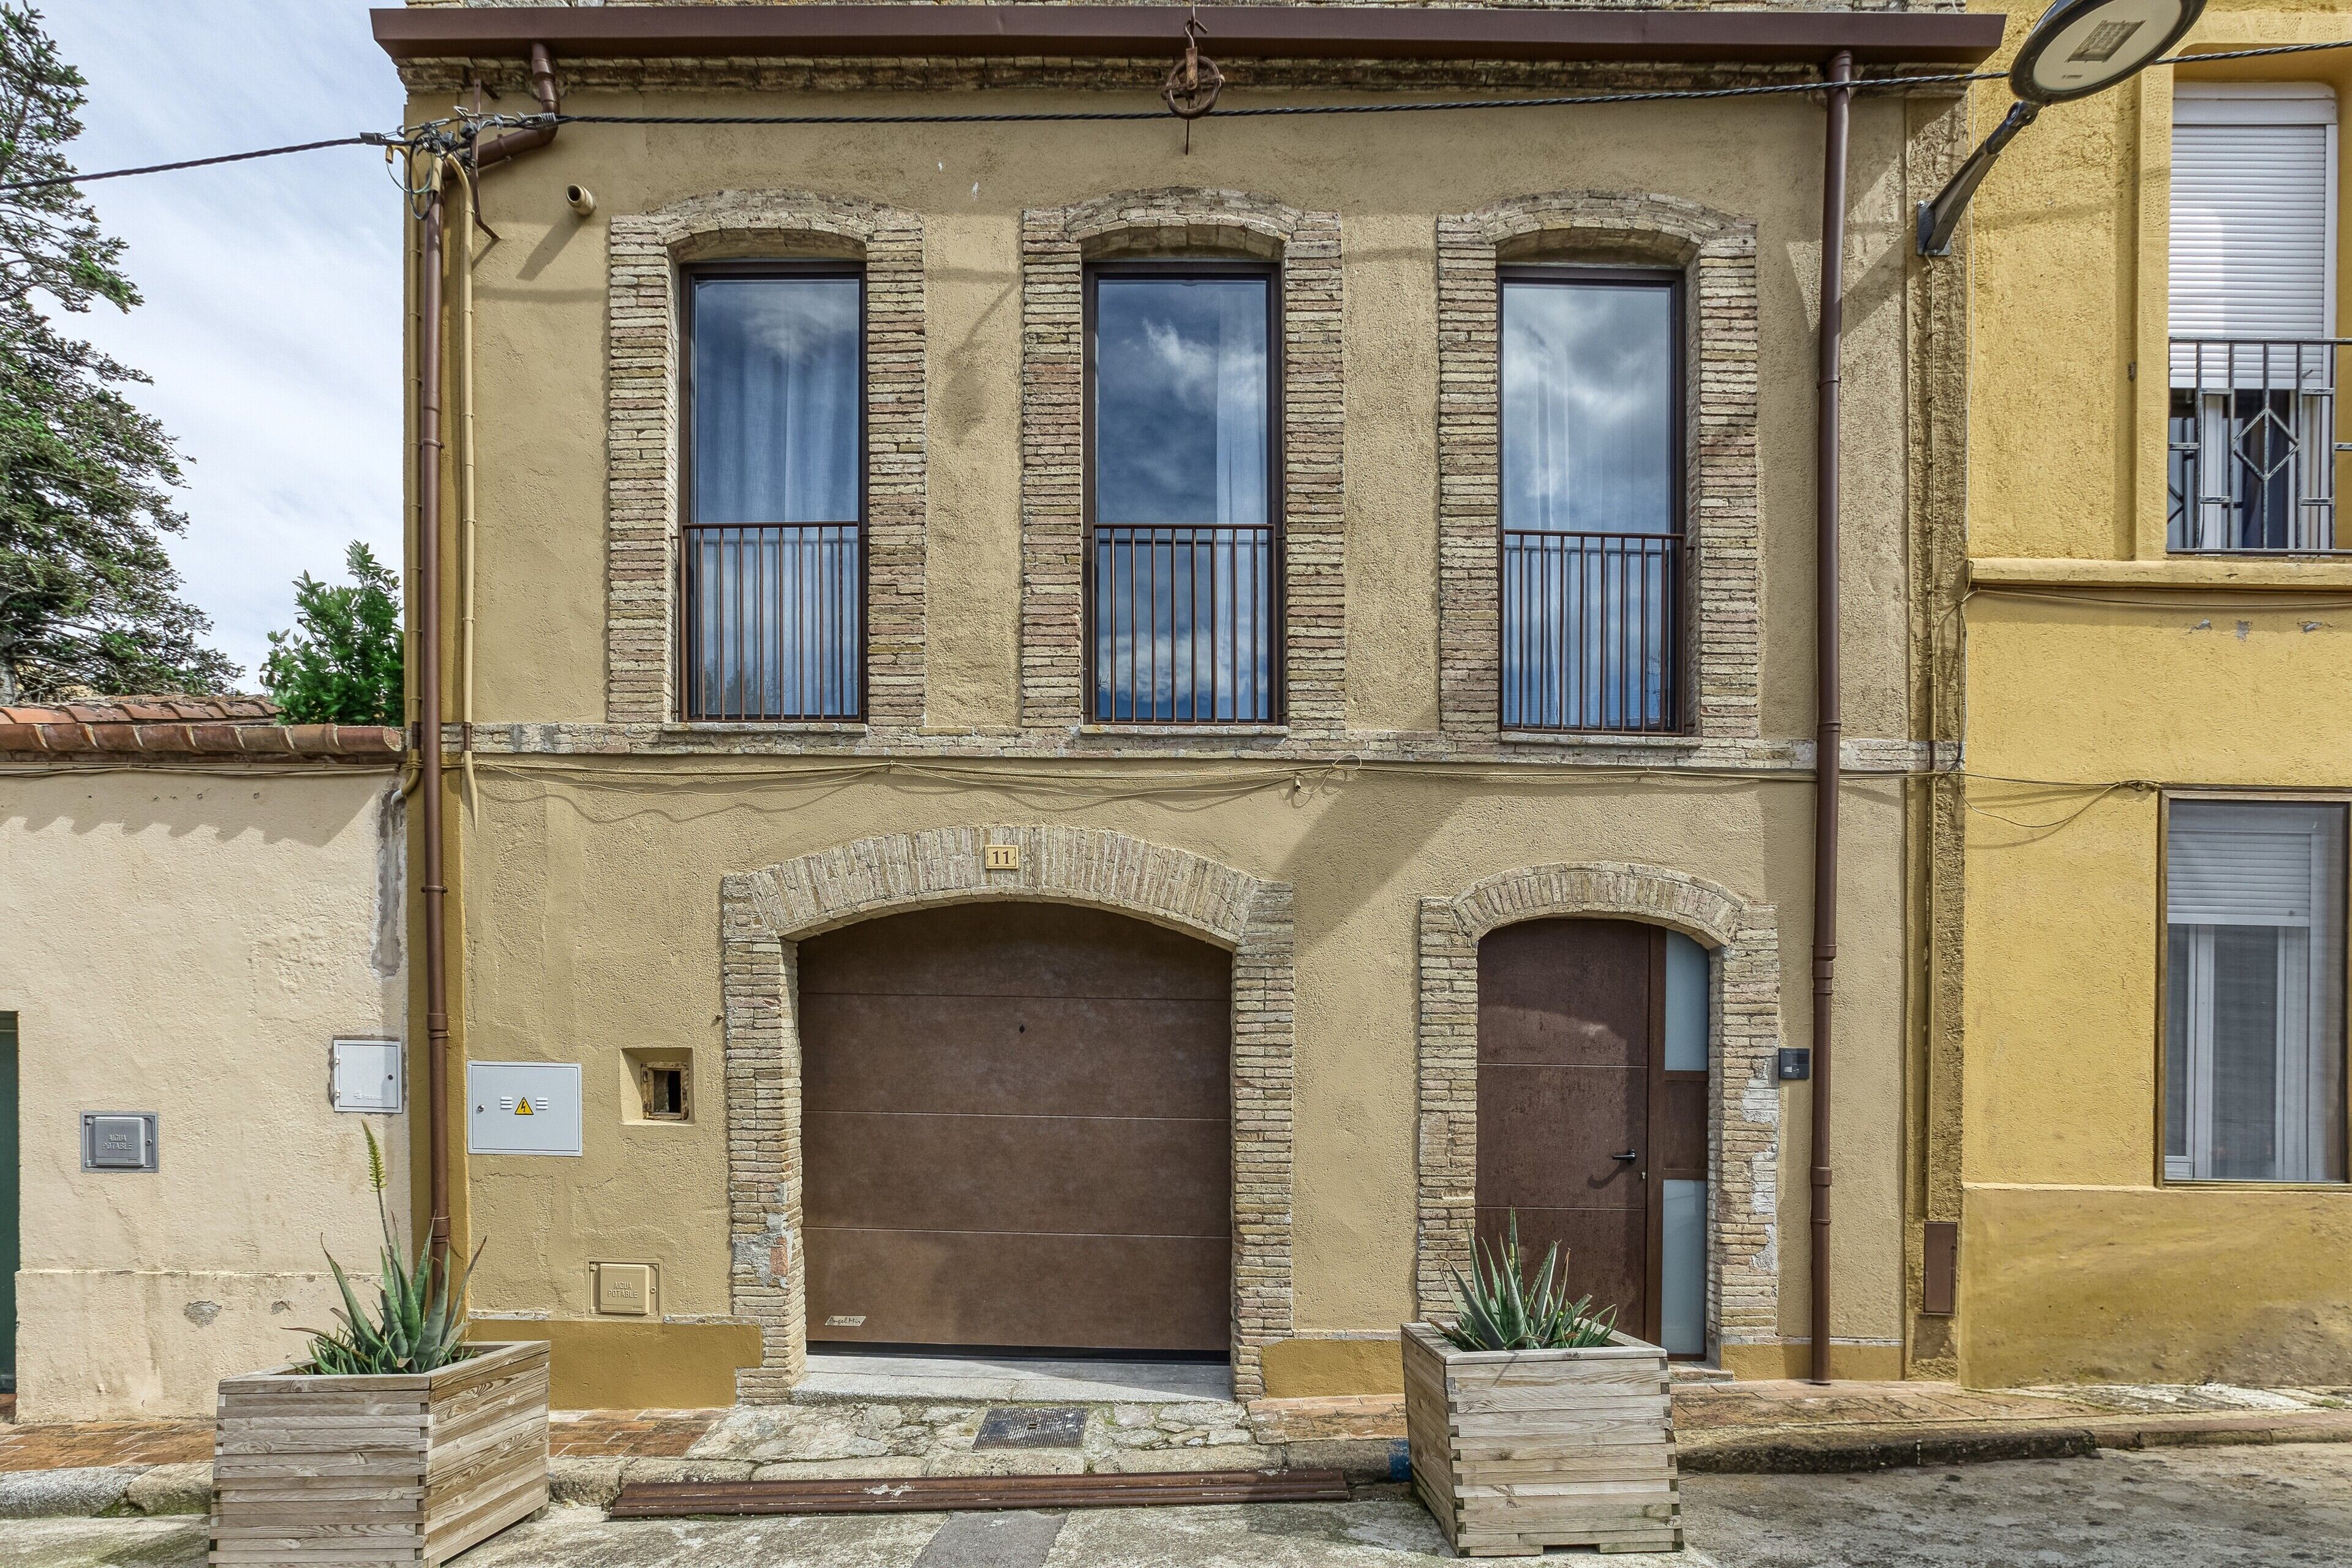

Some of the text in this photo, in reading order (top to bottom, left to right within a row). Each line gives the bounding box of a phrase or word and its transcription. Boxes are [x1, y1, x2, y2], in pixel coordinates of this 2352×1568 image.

[992, 850, 1009, 864] 11
[102, 1142, 133, 1151] POTABLE
[614, 1281, 633, 1290] AIGUA
[608, 1289, 638, 1298] POTABLE
